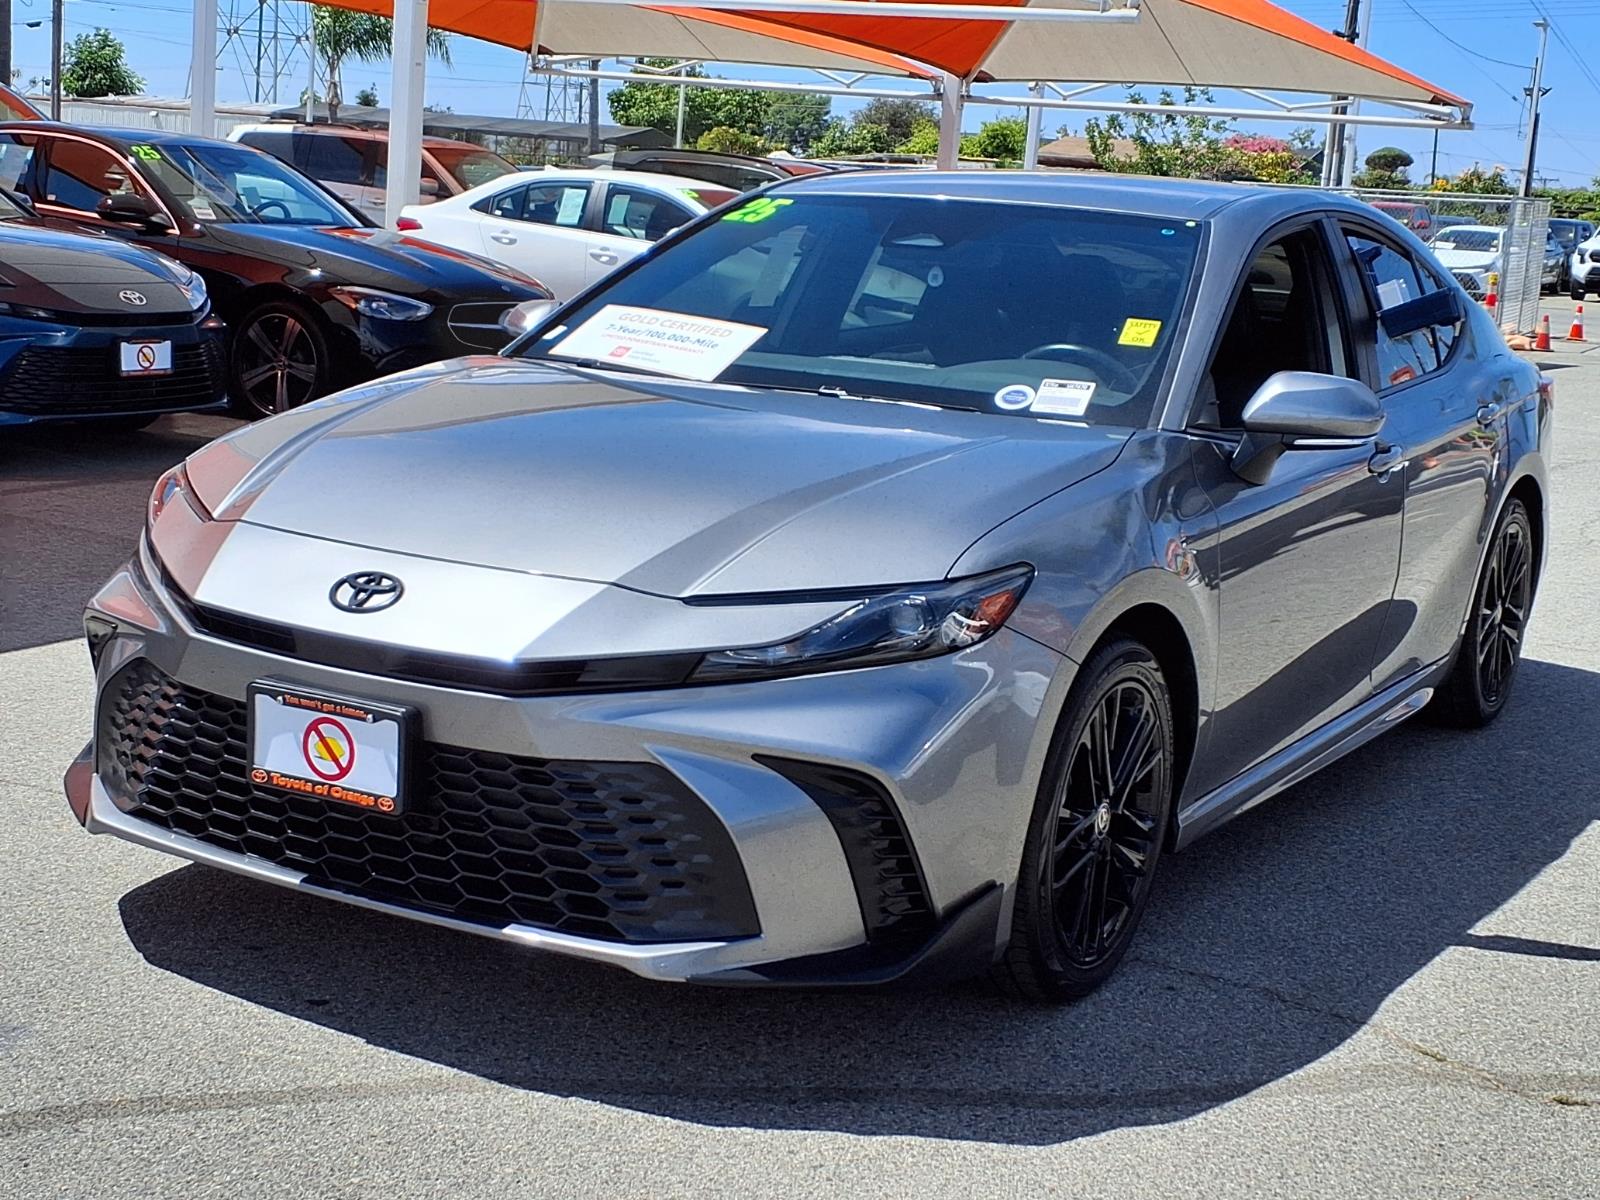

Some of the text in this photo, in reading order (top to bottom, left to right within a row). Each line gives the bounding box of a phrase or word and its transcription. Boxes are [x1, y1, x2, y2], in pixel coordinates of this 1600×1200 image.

[130, 145, 161, 159] 25
[721, 198, 794, 223] 25
[605, 323, 719, 350] 7-Year/100,000-Mile
[618, 312, 733, 338] GOLD CERTIFIED
[284, 694, 300, 704] You
[300, 698, 322, 710] won't
[322, 703, 335, 712] get
[270, 772, 375, 806] Toyota of Orange
